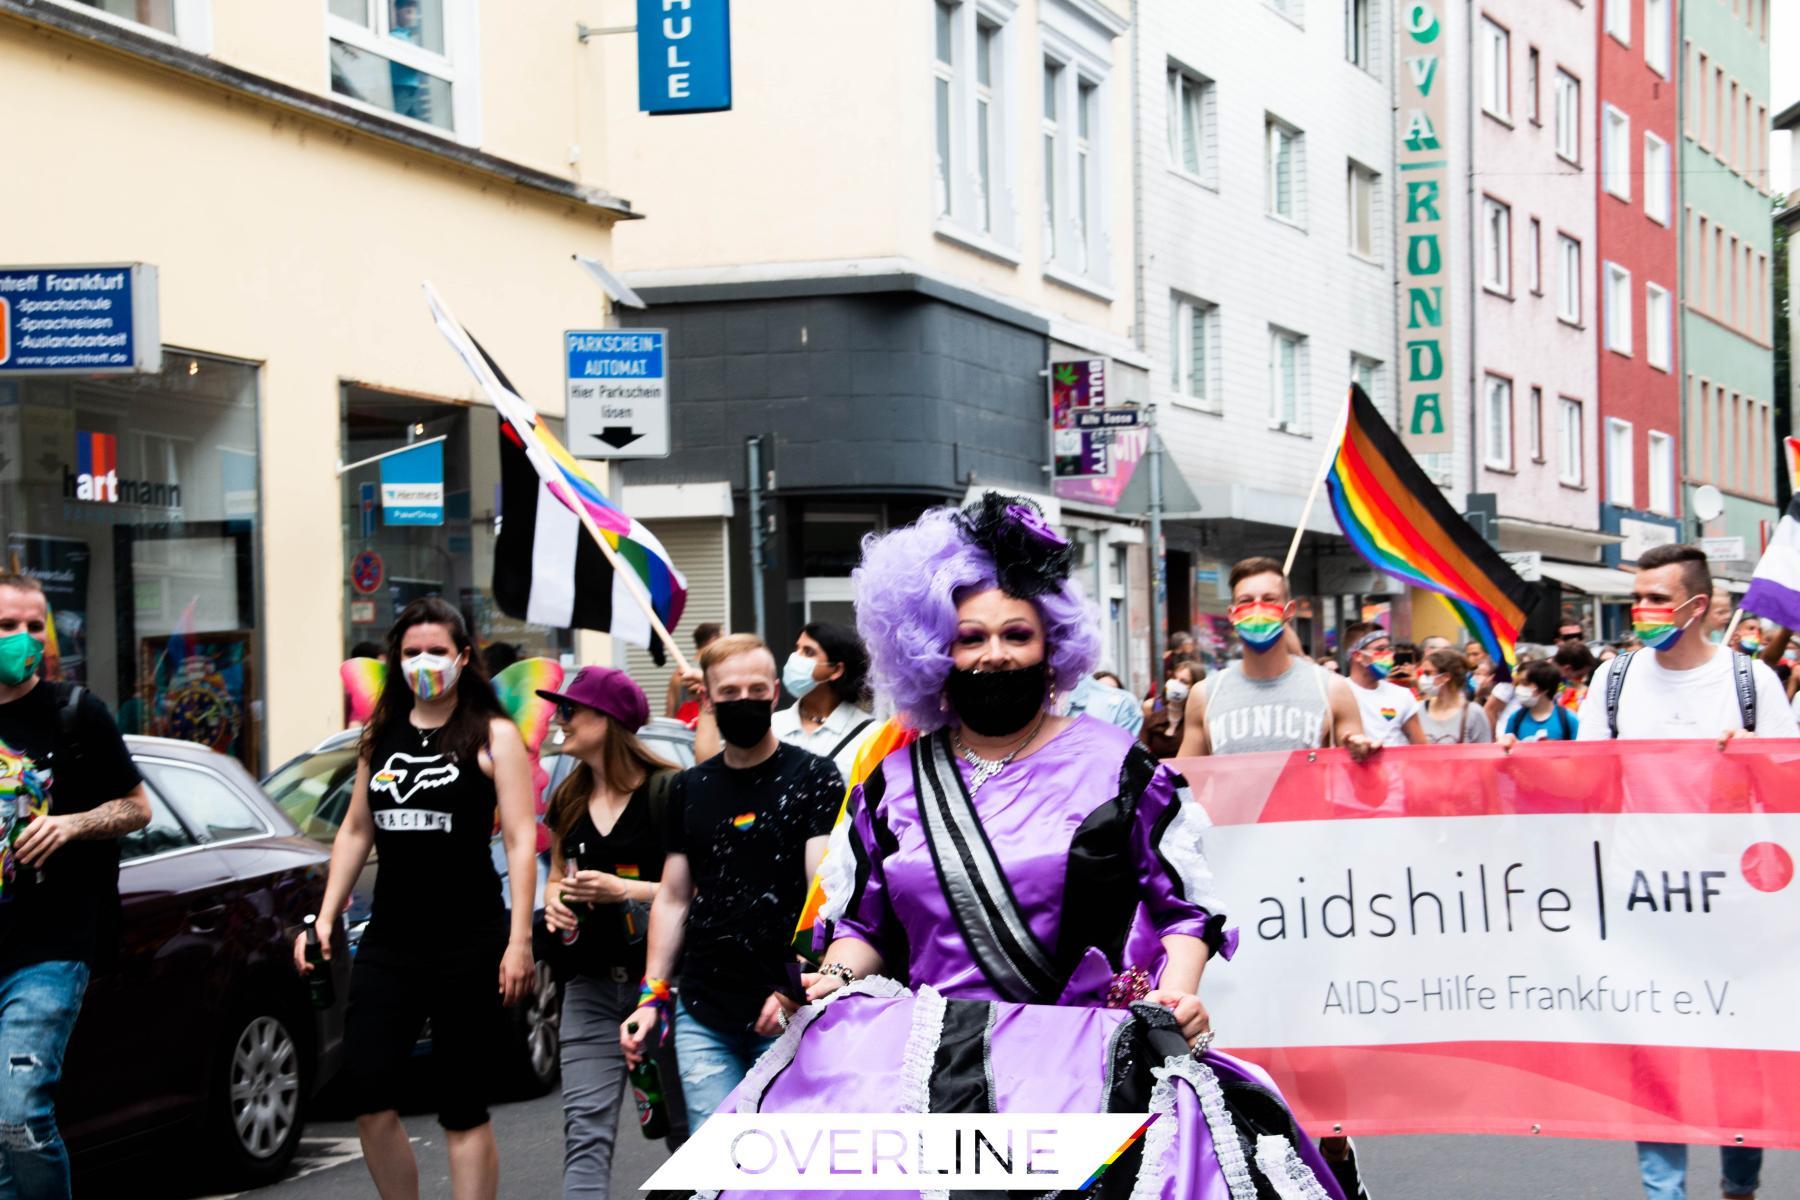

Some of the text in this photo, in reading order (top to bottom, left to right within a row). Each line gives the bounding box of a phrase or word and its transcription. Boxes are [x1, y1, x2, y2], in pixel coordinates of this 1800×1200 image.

[46, 272, 125, 292] Frankfurt
[15, 297, 112, 315] -Sprachschule
[1405, 180, 1444, 435] RONDA
[16, 315, 113, 333] -Sprachreisen
[16, 332, 128, 350] -Auslandsarbeit
[569, 336, 662, 352] PARKSCHEIN-
[16, 352, 128, 367] www.sprachtreff.de
[584, 359, 648, 376] AUTOMAT
[570, 384, 661, 398] Hier Parkschein
[601, 404, 633, 418] lösen
[63, 464, 181, 507] hartmann
[396, 489, 440, 501] Hermes
[1209, 703, 1325, 752] MUNICH
[377, 811, 448, 828] RACING
[1256, 861, 1727, 941] aidshilfe AHF
[1322, 974, 1736, 1017] AIDS-Hilfe Frankfurt e.V.
